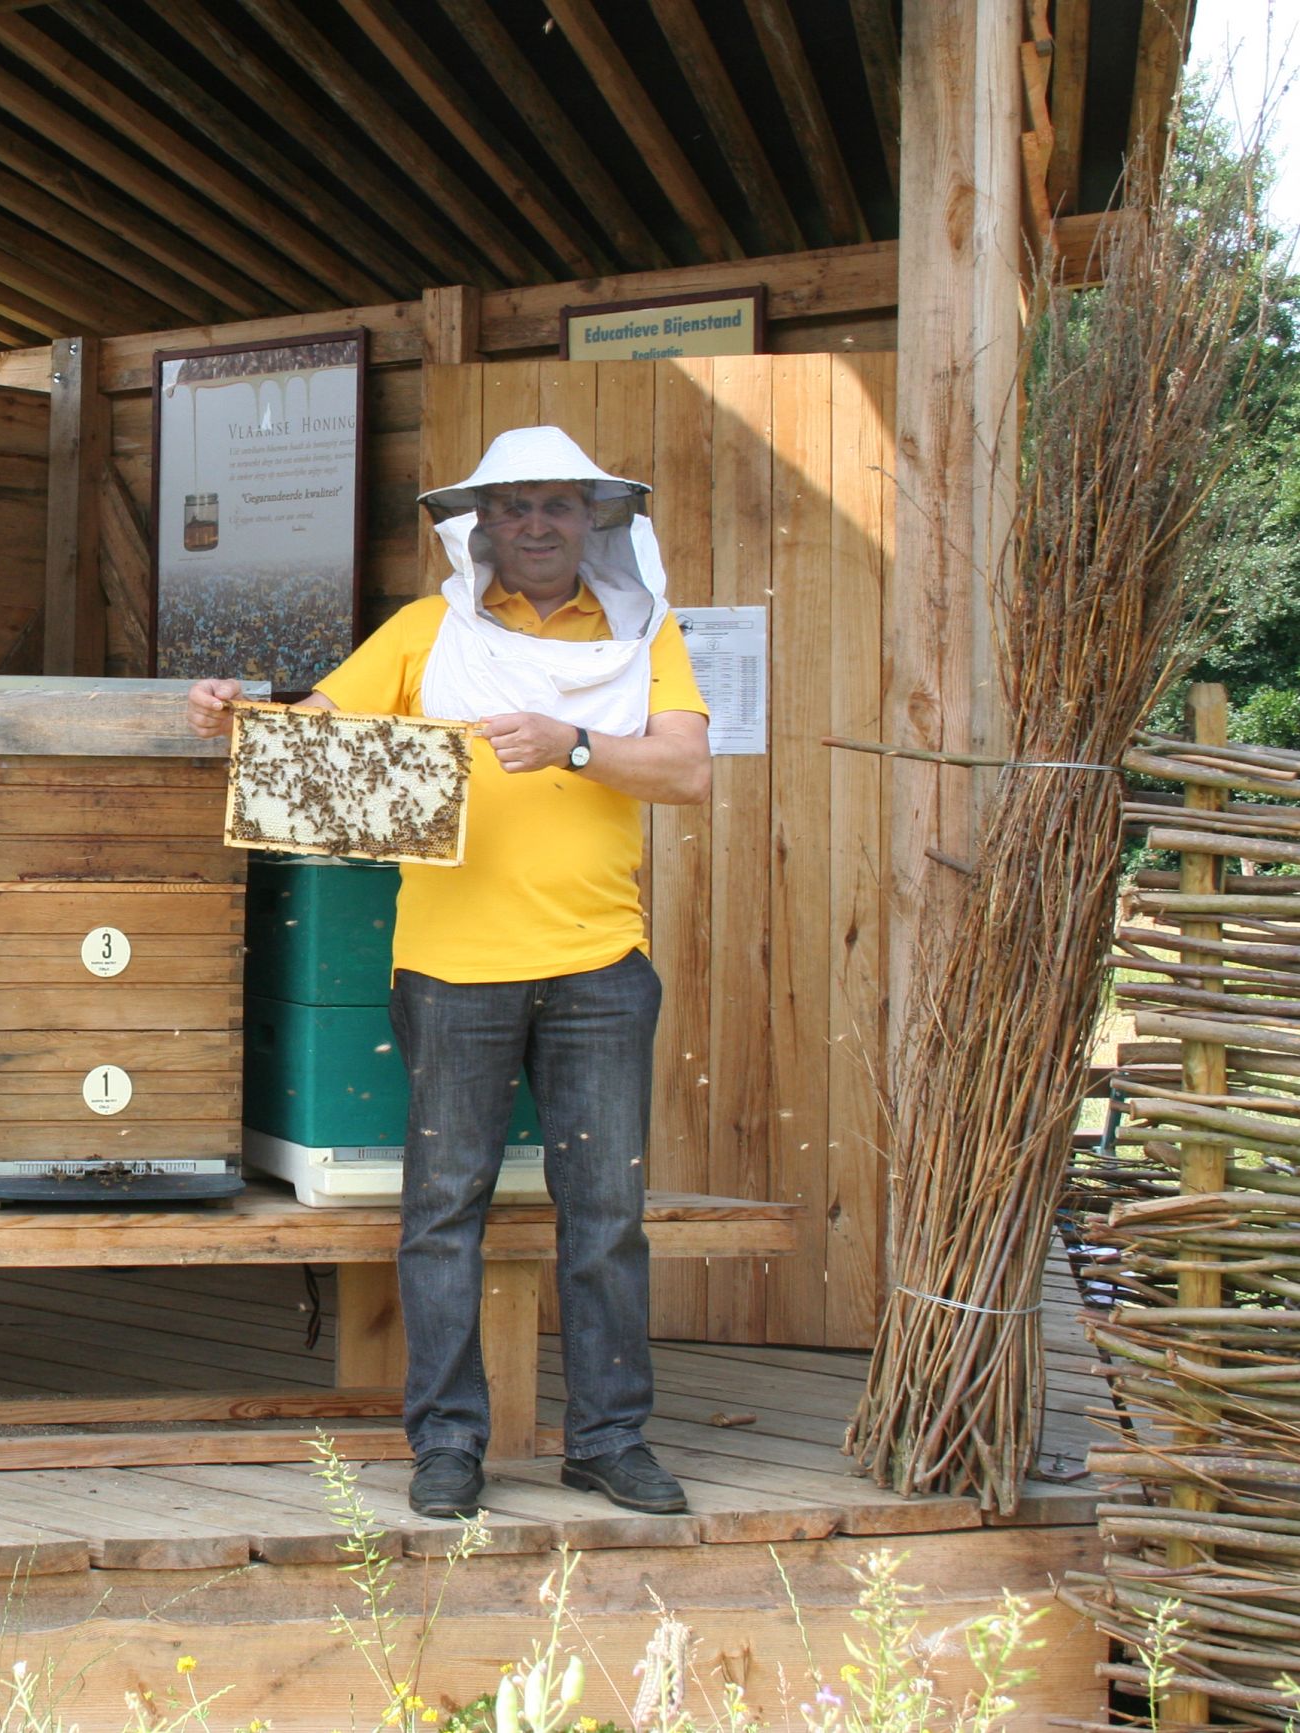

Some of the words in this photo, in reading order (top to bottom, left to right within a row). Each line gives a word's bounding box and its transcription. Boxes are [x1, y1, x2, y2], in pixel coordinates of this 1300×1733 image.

[584, 322, 659, 343] Educatieve
[663, 309, 742, 336] Bijenstand
[632, 345, 684, 361] Realisatie:
[301, 414, 356, 433] HONING
[102, 932, 112, 959] 3
[102, 1071, 109, 1097] 1
